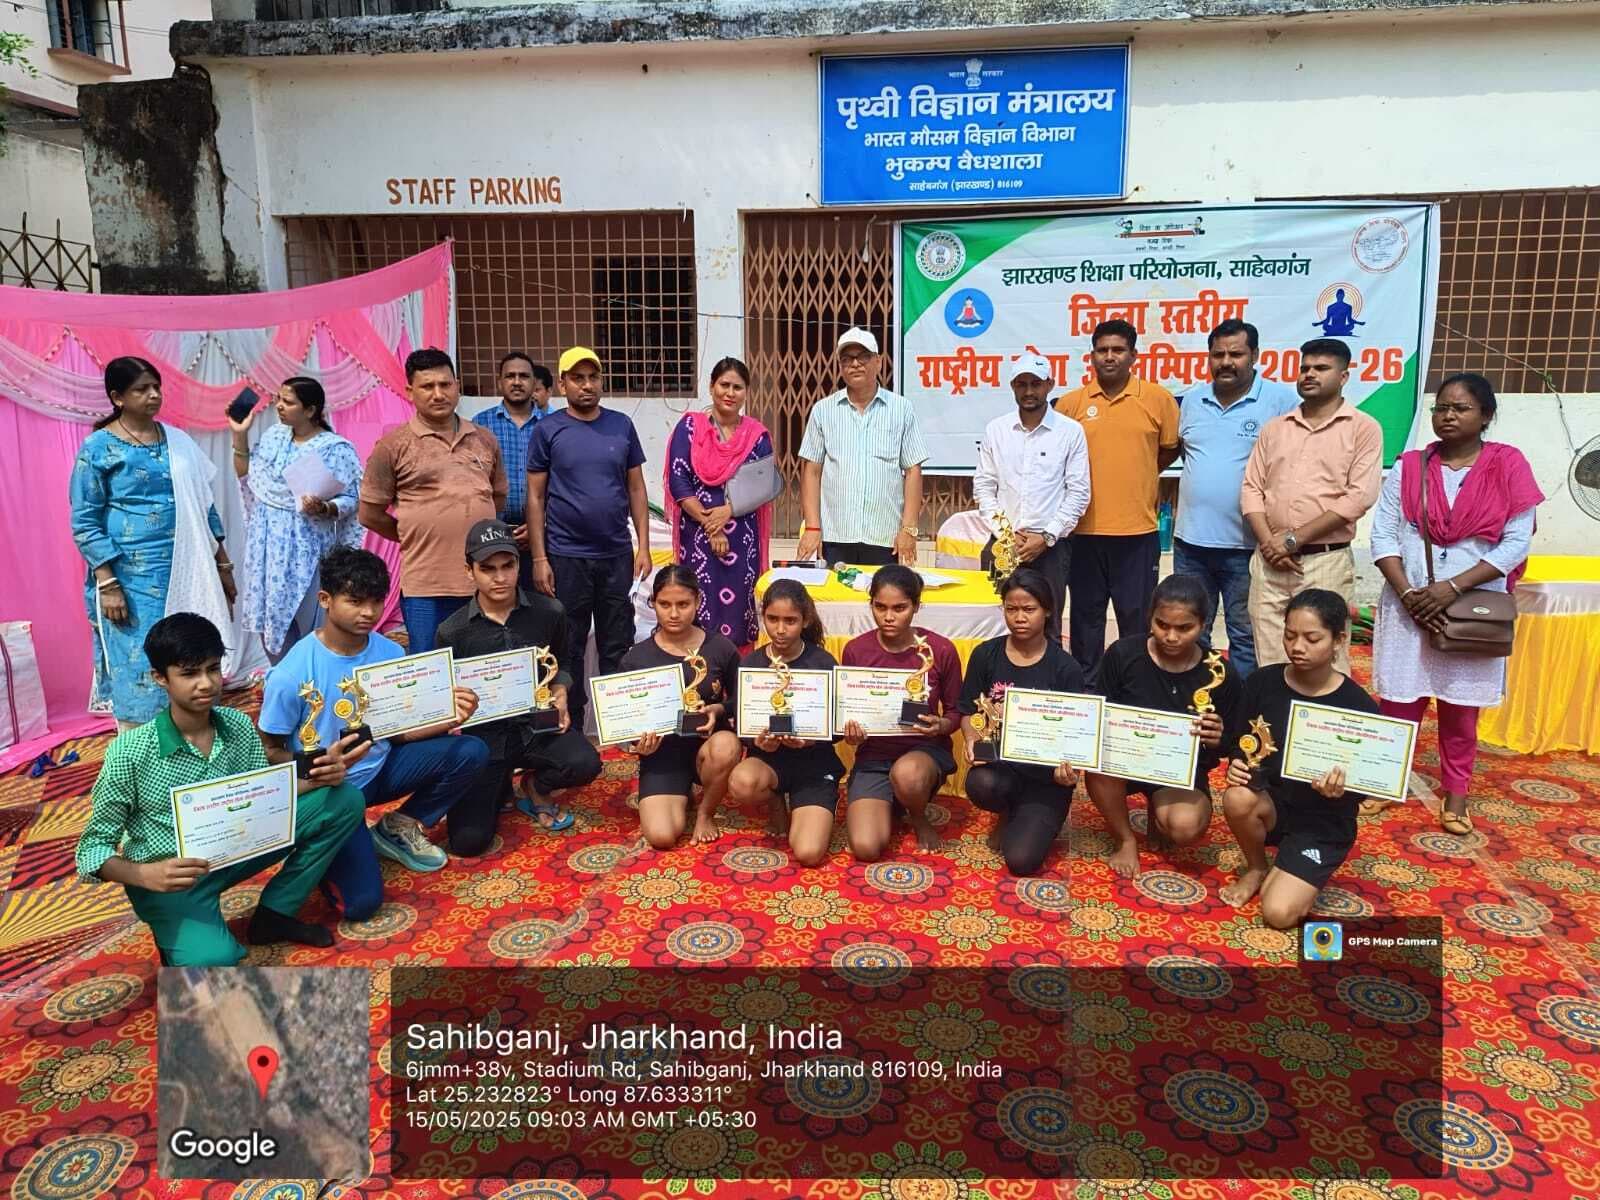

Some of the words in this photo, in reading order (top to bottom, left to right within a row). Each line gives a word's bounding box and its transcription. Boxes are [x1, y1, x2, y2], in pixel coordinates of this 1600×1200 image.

[837, 86, 901, 129] पृथ्वी
[909, 84, 1000, 120] विज्ञान
[1008, 82, 1116, 115] मंत्रालय
[864, 131, 906, 148] भारत
[911, 125, 959, 146] मौसम
[965, 123, 1017, 145] विज्ञान
[1022, 122, 1076, 144] विभाग
[885, 155, 952, 181] भुकम्प
[386, 178, 457, 206] STAFF
[469, 175, 562, 206] PARKING
[996, 179, 1024, 190] 816109
[1002, 266, 1077, 287] झारखण्ड
[1081, 260, 1124, 283] शिक्षा
[1130, 257, 1222, 281] परियोजना,
[1229, 252, 1312, 278] साहेबगंज
[916, 346, 1003, 395] राष्ट्रीय
[1259, 347, 1404, 383] 20-26
